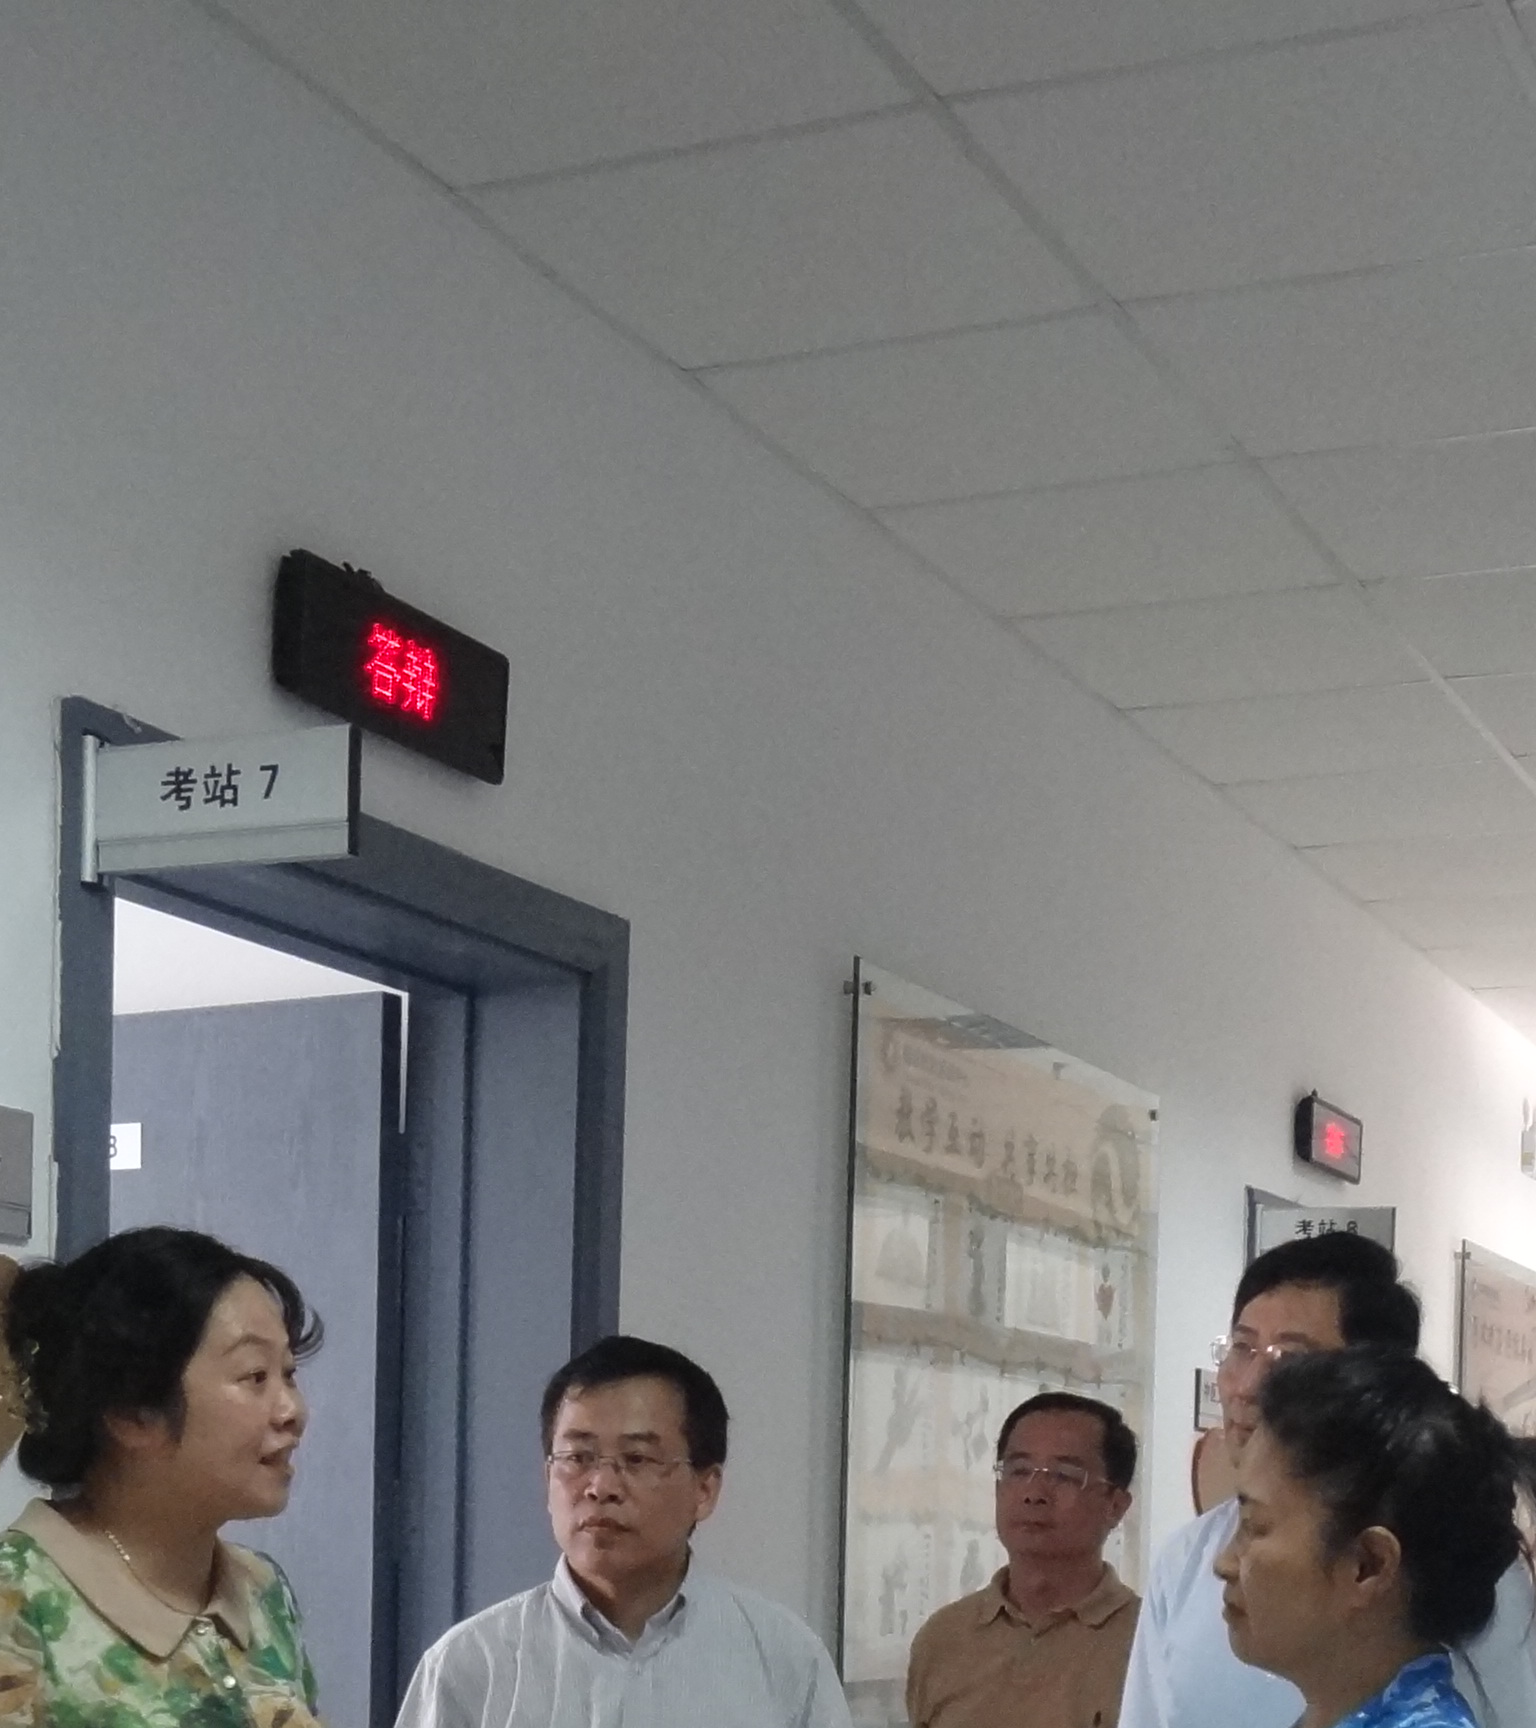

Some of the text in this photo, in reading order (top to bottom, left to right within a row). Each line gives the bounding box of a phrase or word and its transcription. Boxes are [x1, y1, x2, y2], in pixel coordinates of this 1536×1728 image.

[366, 622, 436, 720] 答辩
[160, 763, 279, 811] 考站 7
